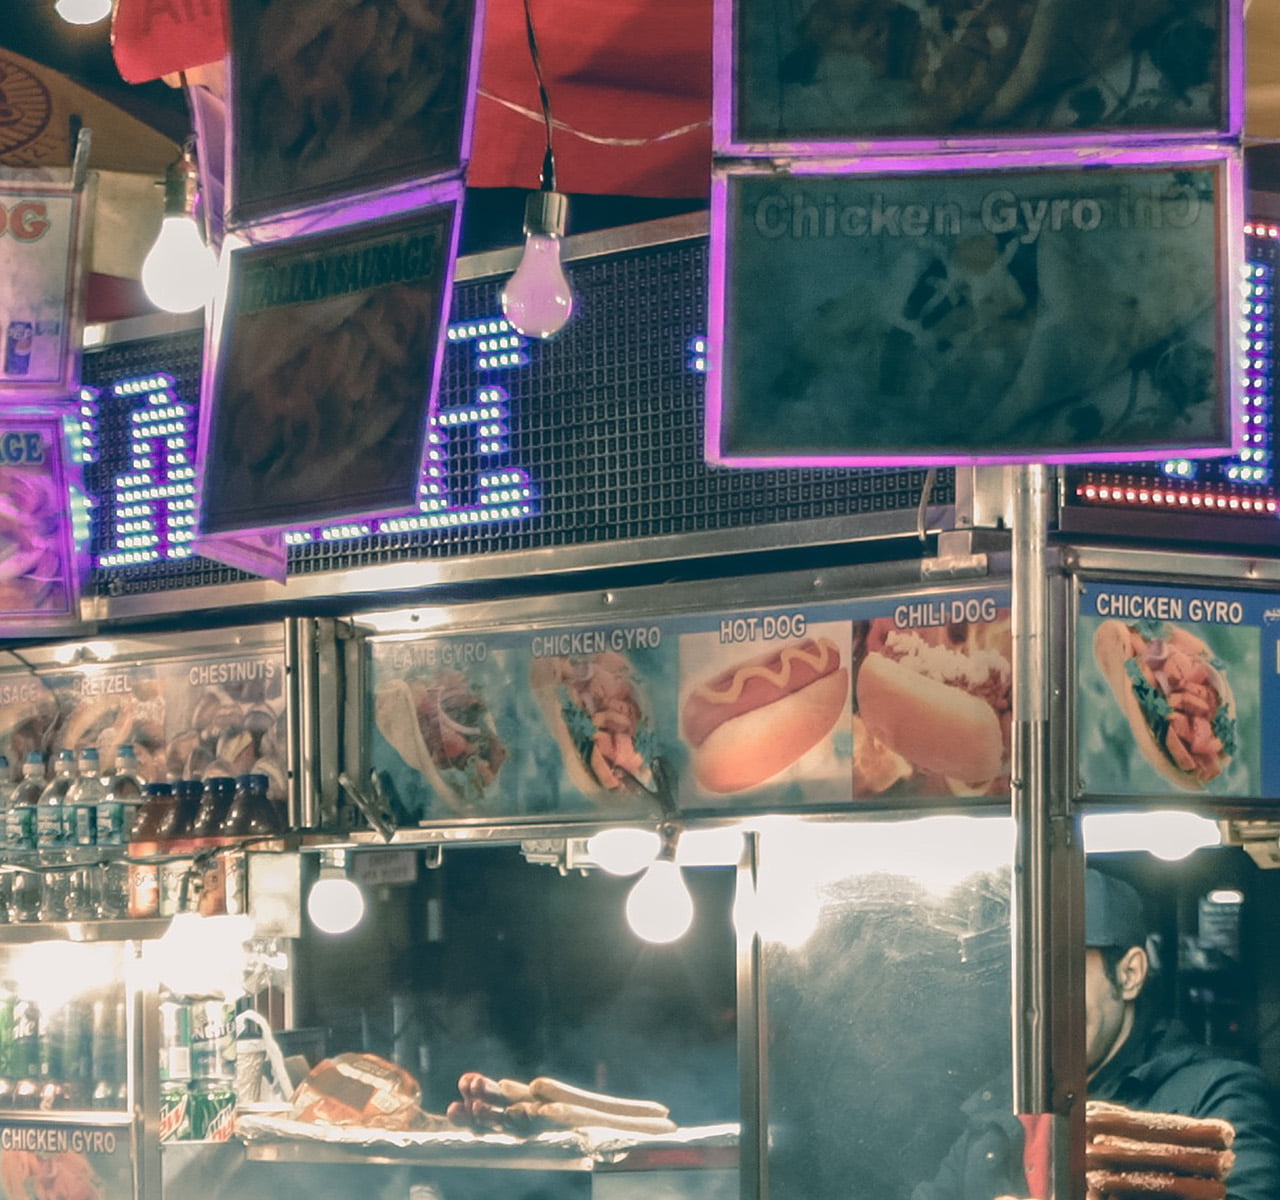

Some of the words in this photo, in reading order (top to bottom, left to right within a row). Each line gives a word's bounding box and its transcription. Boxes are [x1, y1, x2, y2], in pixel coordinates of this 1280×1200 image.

[754, 192, 962, 240] Chicken
[981, 188, 1103, 244] Gyro
[893, 601, 943, 628] CHILI
[948, 597, 997, 625] DOG
[1096, 592, 1183, 620] CHICKEN
[1188, 597, 1243, 624] GYRO
[531, 630, 607, 658] CHICKEN
[611, 626, 661, 654] GYRO
[719, 617, 757, 643] HOT
[760, 614, 807, 640] DOG
[440, 640, 488, 666] GYRO
[73, 675, 132, 697] PRETZEL
[189, 661, 275, 686] CHESTNUTS
[0, 1127, 68, 1152] CHICKEN
[71, 1130, 116, 1155] GYRO
